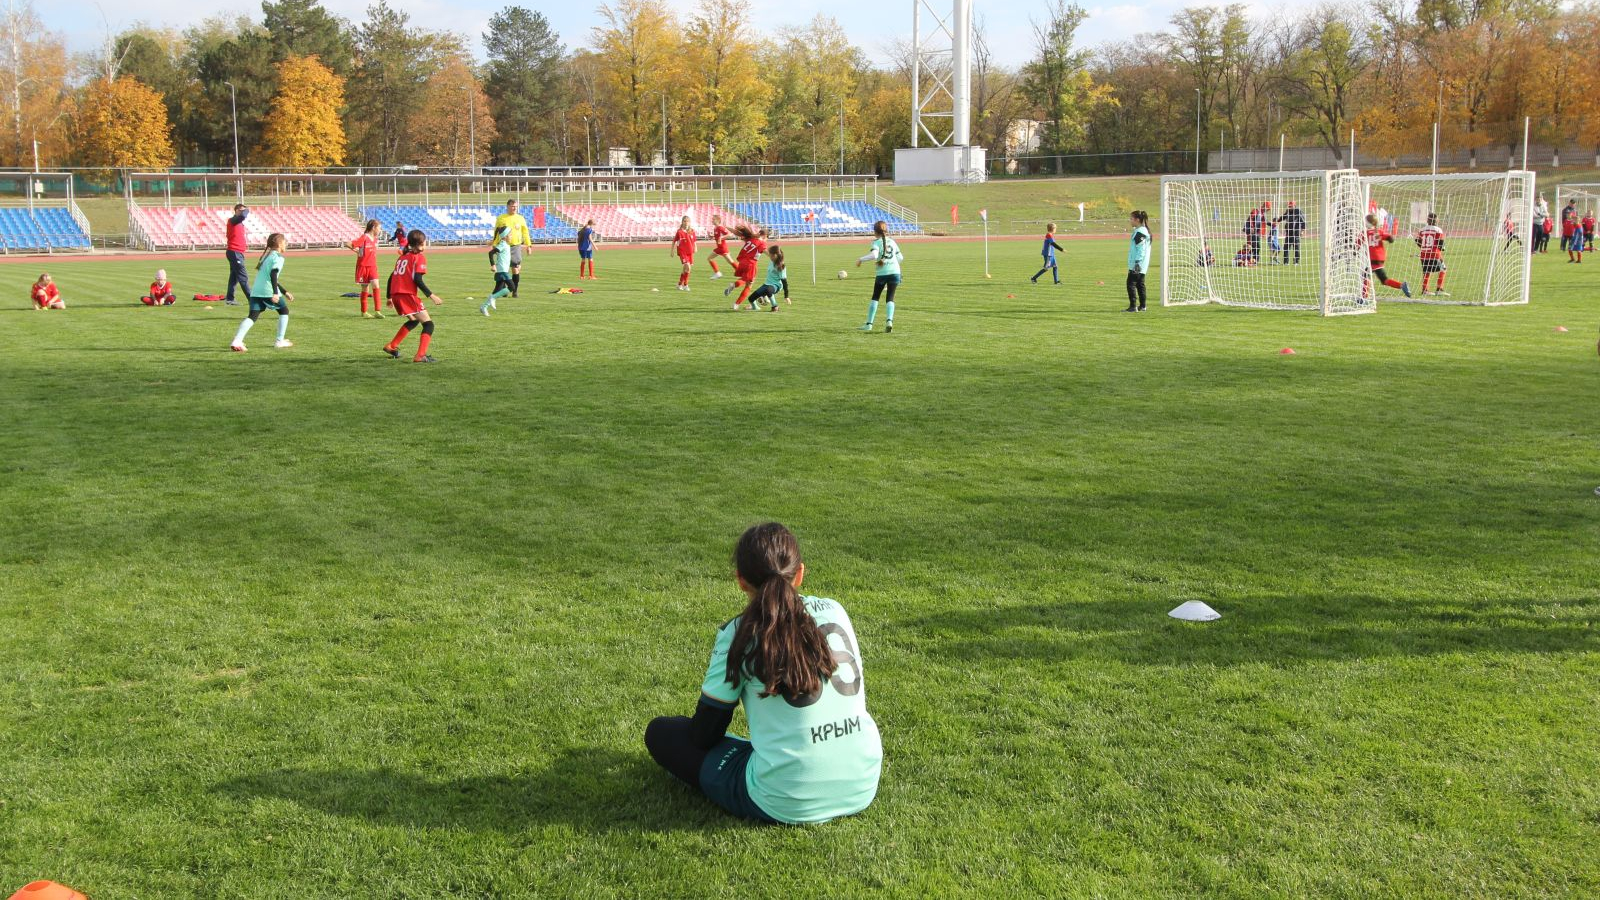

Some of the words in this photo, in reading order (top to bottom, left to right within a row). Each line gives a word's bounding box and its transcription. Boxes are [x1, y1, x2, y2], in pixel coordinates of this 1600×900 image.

[744, 241, 756, 254] 27
[394, 259, 408, 275] 38
[811, 715, 861, 744] КРЫМ
